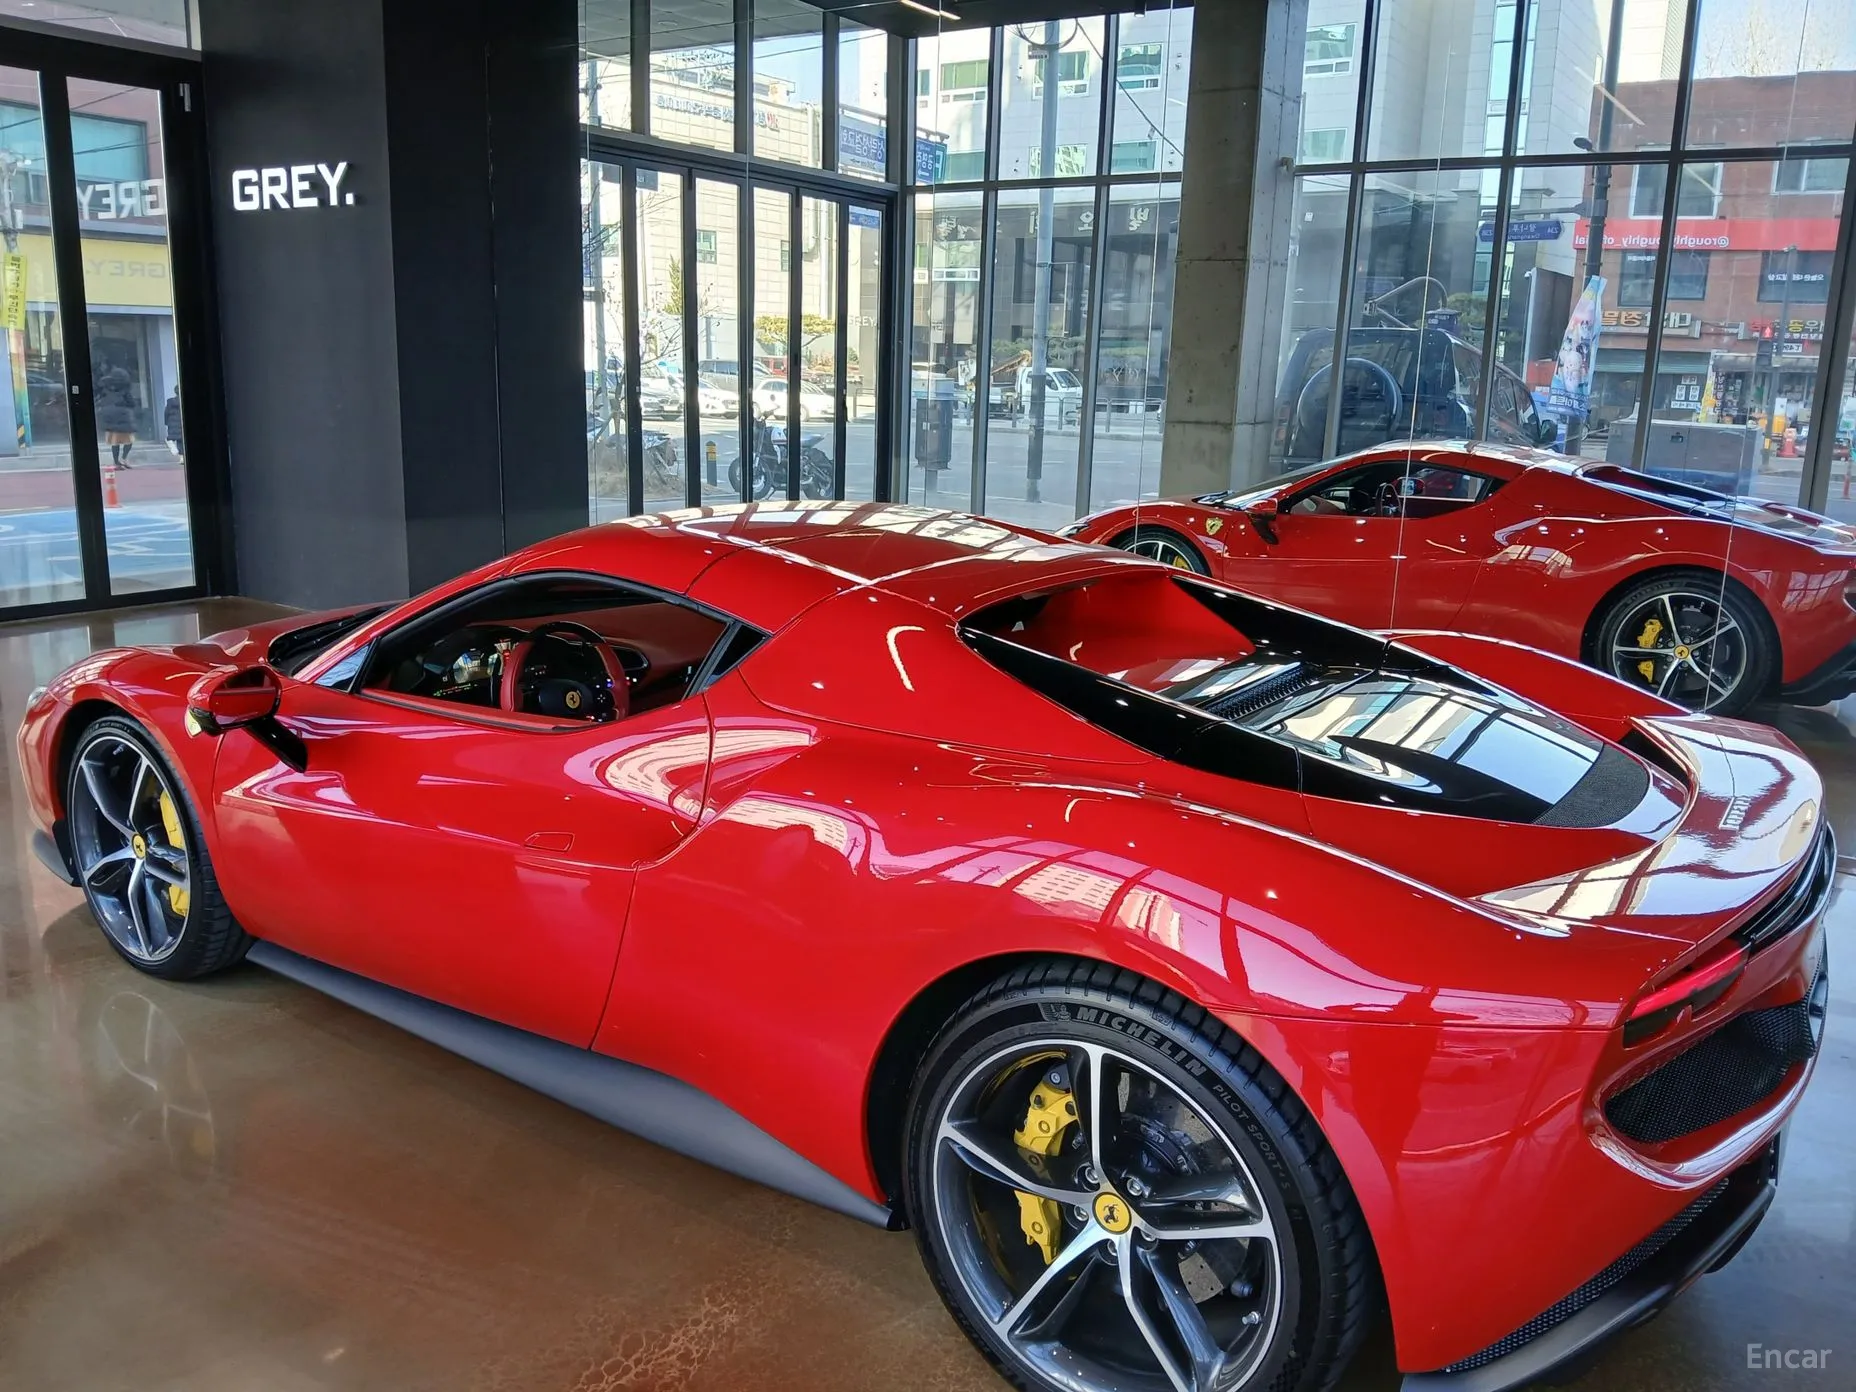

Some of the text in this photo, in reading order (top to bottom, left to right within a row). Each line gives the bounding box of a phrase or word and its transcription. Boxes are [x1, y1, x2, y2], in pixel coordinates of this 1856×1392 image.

[232, 161, 355, 211] GREY.
[1076, 1006, 1207, 1076] MICHELIN
[1212, 1084, 1249, 1119] PILOT
[1247, 1123, 1282, 1170] SPORT
